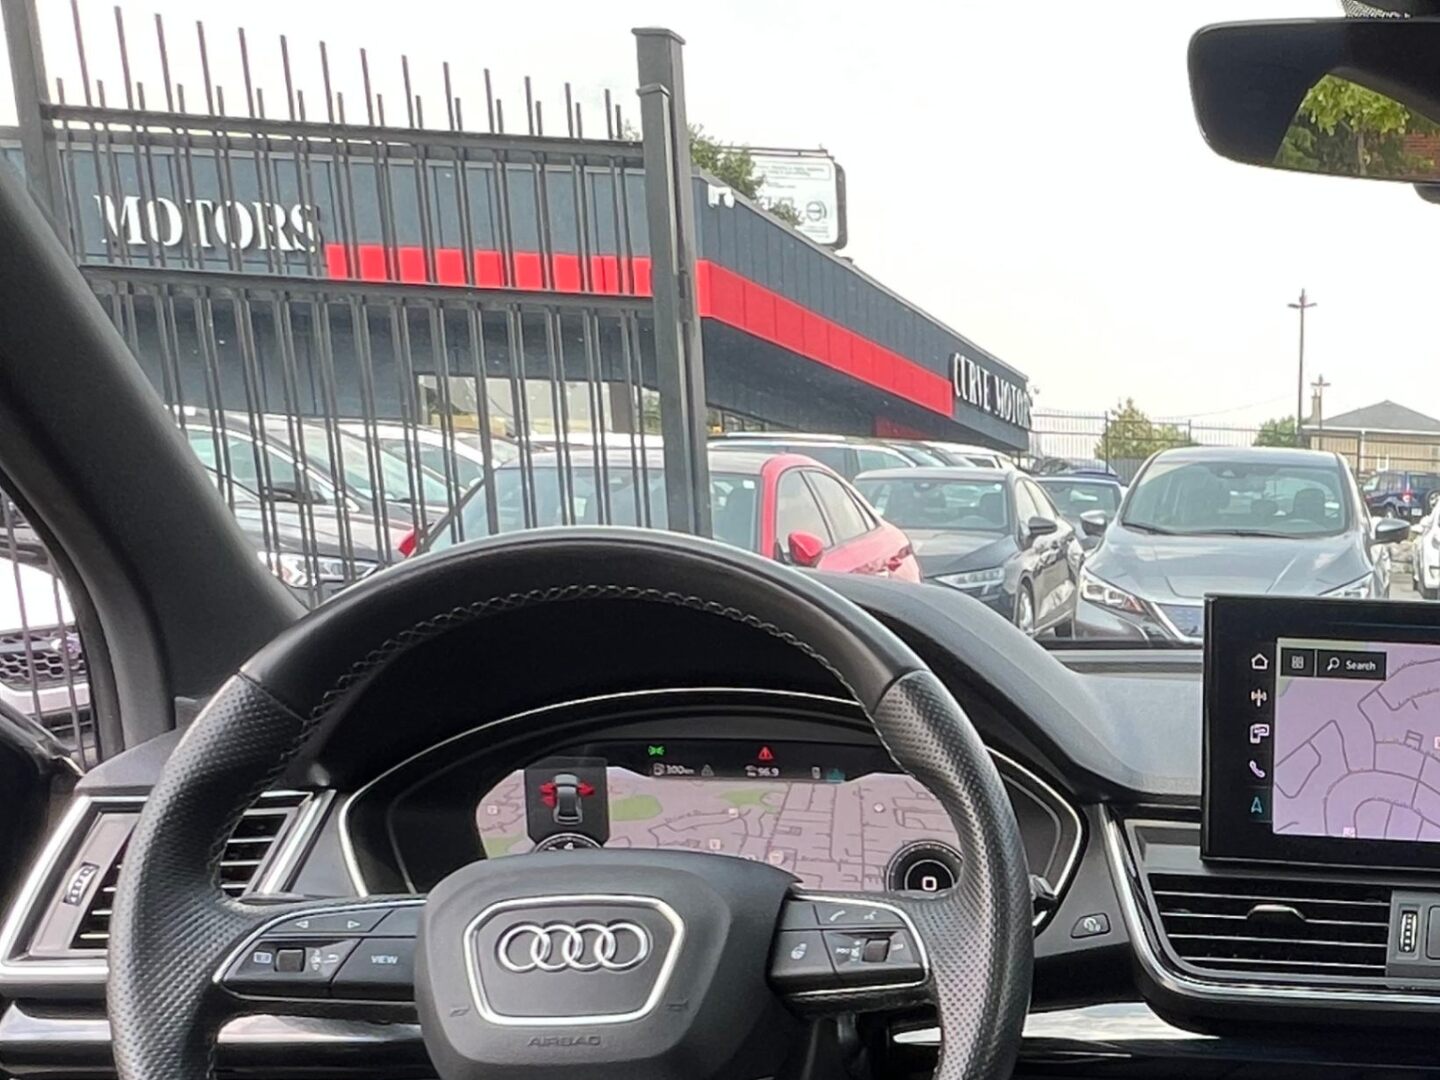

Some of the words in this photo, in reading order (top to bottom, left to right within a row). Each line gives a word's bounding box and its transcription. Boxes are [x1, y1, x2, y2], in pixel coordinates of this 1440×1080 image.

[93, 194, 326, 253] MOTORS
[1345, 659, 1376, 672] Search
[922, 876, 938, 891] 0
[371, 955, 398, 964] VIEW
